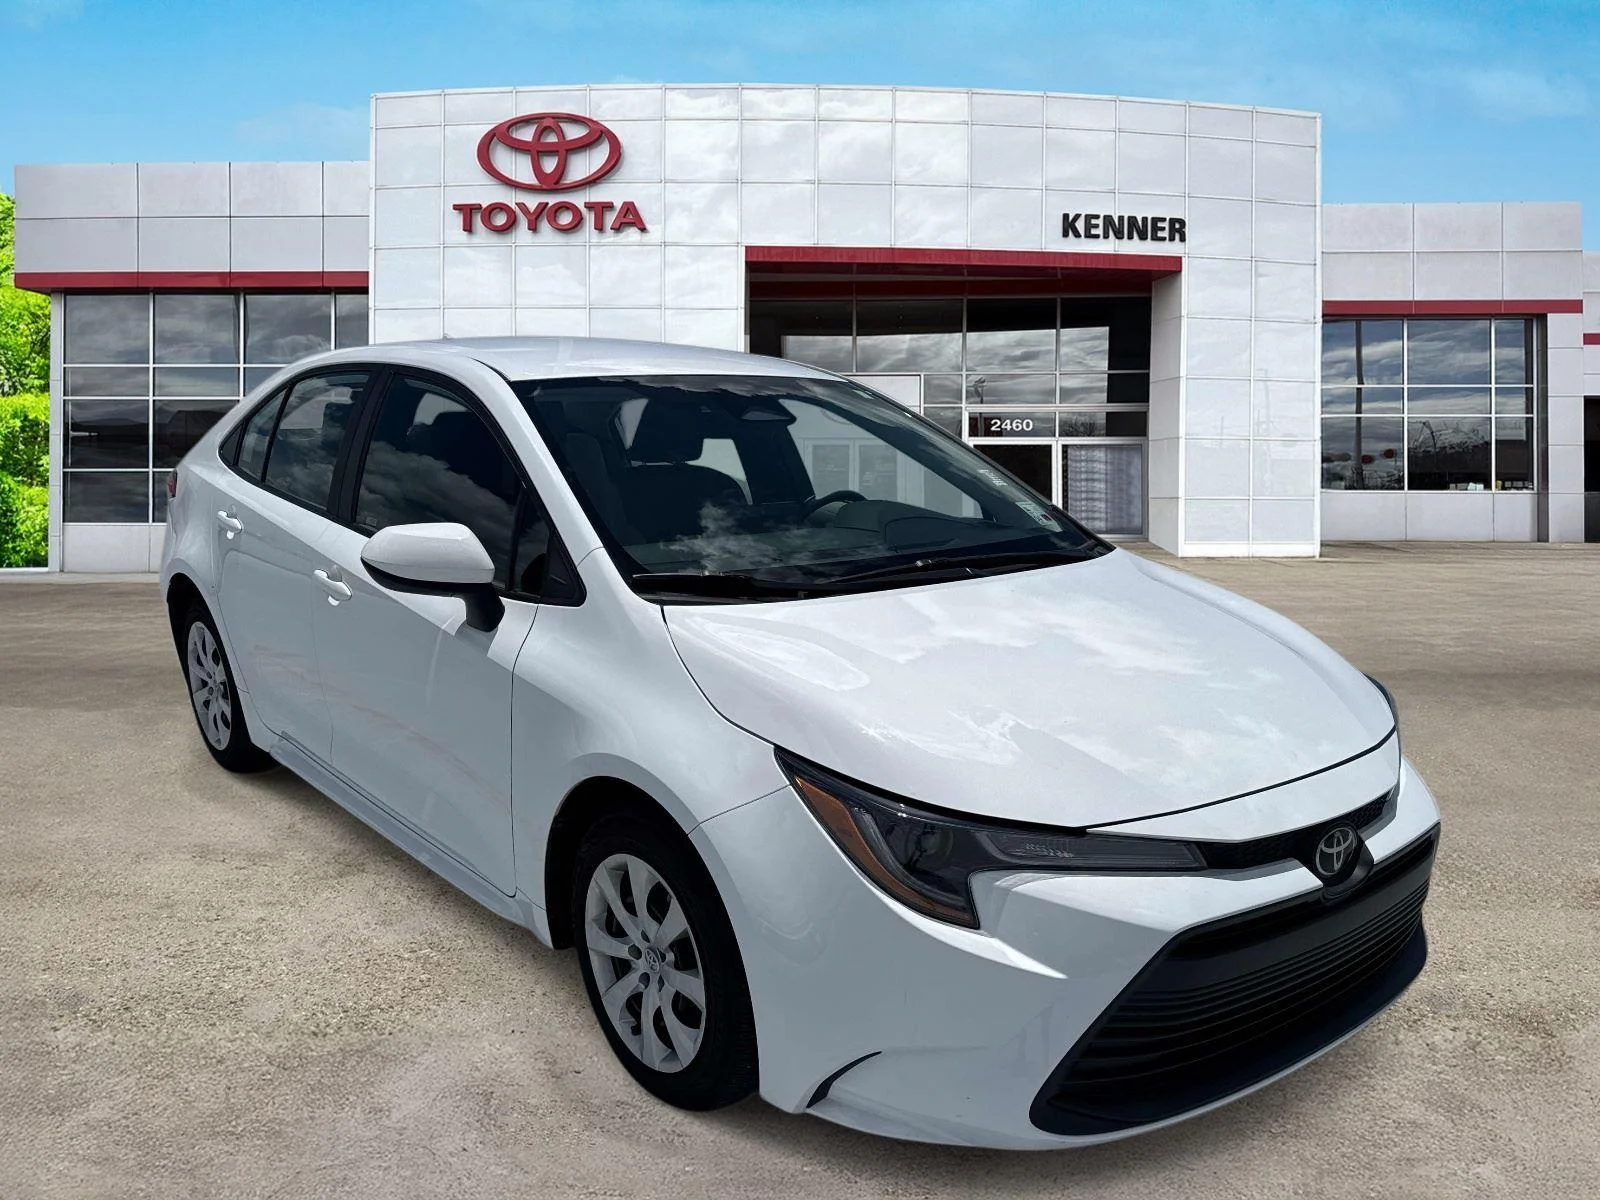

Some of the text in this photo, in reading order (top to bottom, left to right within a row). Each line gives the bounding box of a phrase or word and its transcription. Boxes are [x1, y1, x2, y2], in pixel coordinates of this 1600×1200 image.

[452, 200, 647, 232] TOYOTA
[1062, 212, 1187, 243] KENNER
[990, 418, 1034, 432] 2460
